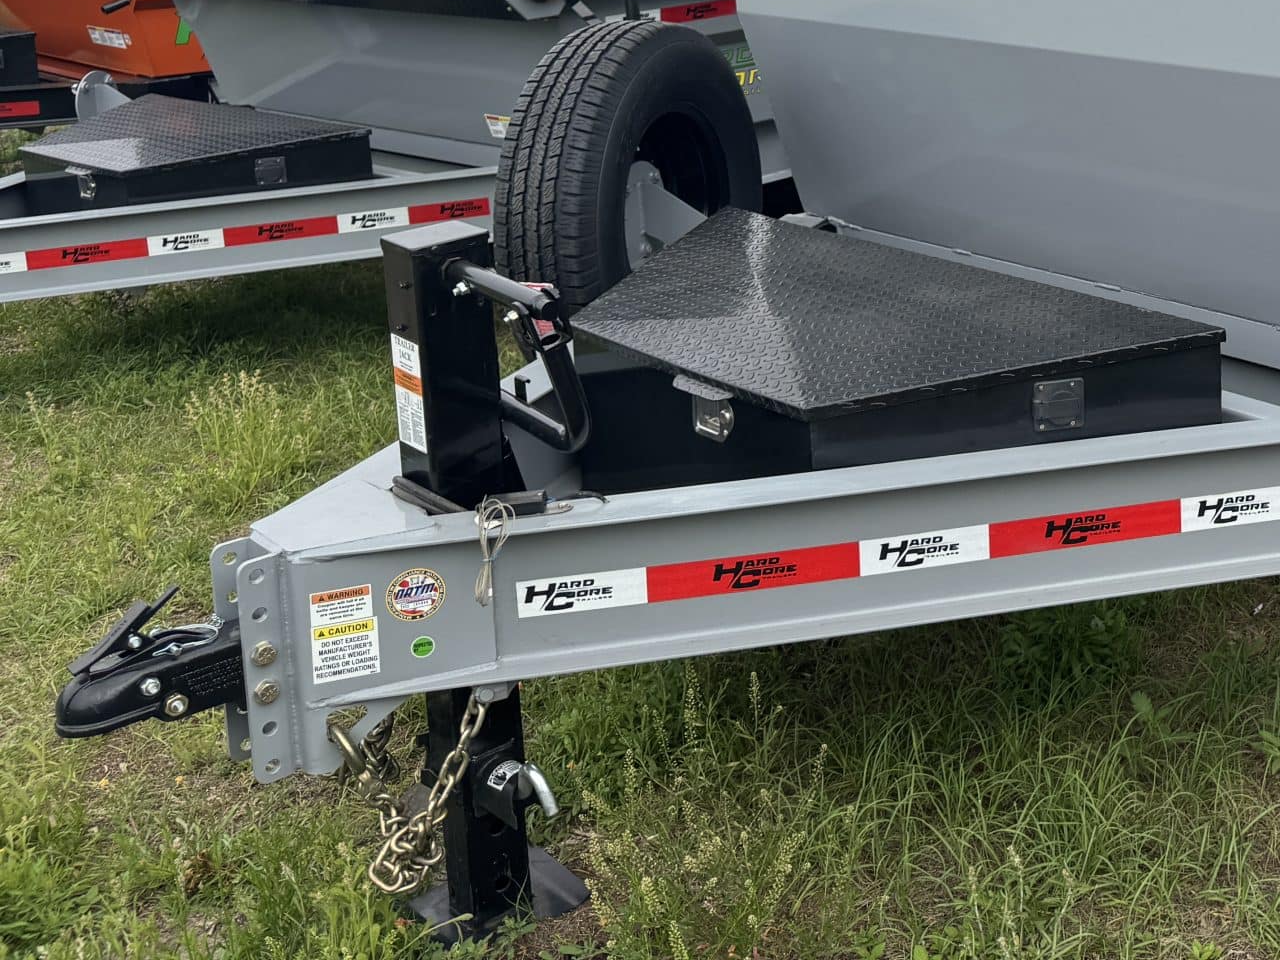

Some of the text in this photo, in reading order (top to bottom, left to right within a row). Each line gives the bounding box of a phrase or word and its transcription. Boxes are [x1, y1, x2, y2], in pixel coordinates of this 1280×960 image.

[162, 233, 200, 249] HARD
[1197, 494, 1255, 522] HARD
[1213, 501, 1270, 524] CORE
[1044, 513, 1106, 544] HARD
[1061, 521, 1121, 544] CORE
[878, 535, 944, 567] HARD
[896, 542, 960, 568] CORE
[712, 556, 781, 589] HARD
[730, 564, 798, 589] CORE
[326, 587, 364, 600] WARNING
[524, 579, 595, 610] HARD
[544, 586, 613, 611] CORE
[328, 622, 368, 636] CAUTION
[331, 638, 344, 646] NOT
[345, 634, 369, 644] EXCEED
[318, 641, 373, 656] MANUFACTURER'S
[321, 648, 371, 663] VEHICLE WEIGHT
[314, 662, 341, 672] RATINGS
[351, 655, 378, 666] LOADING
